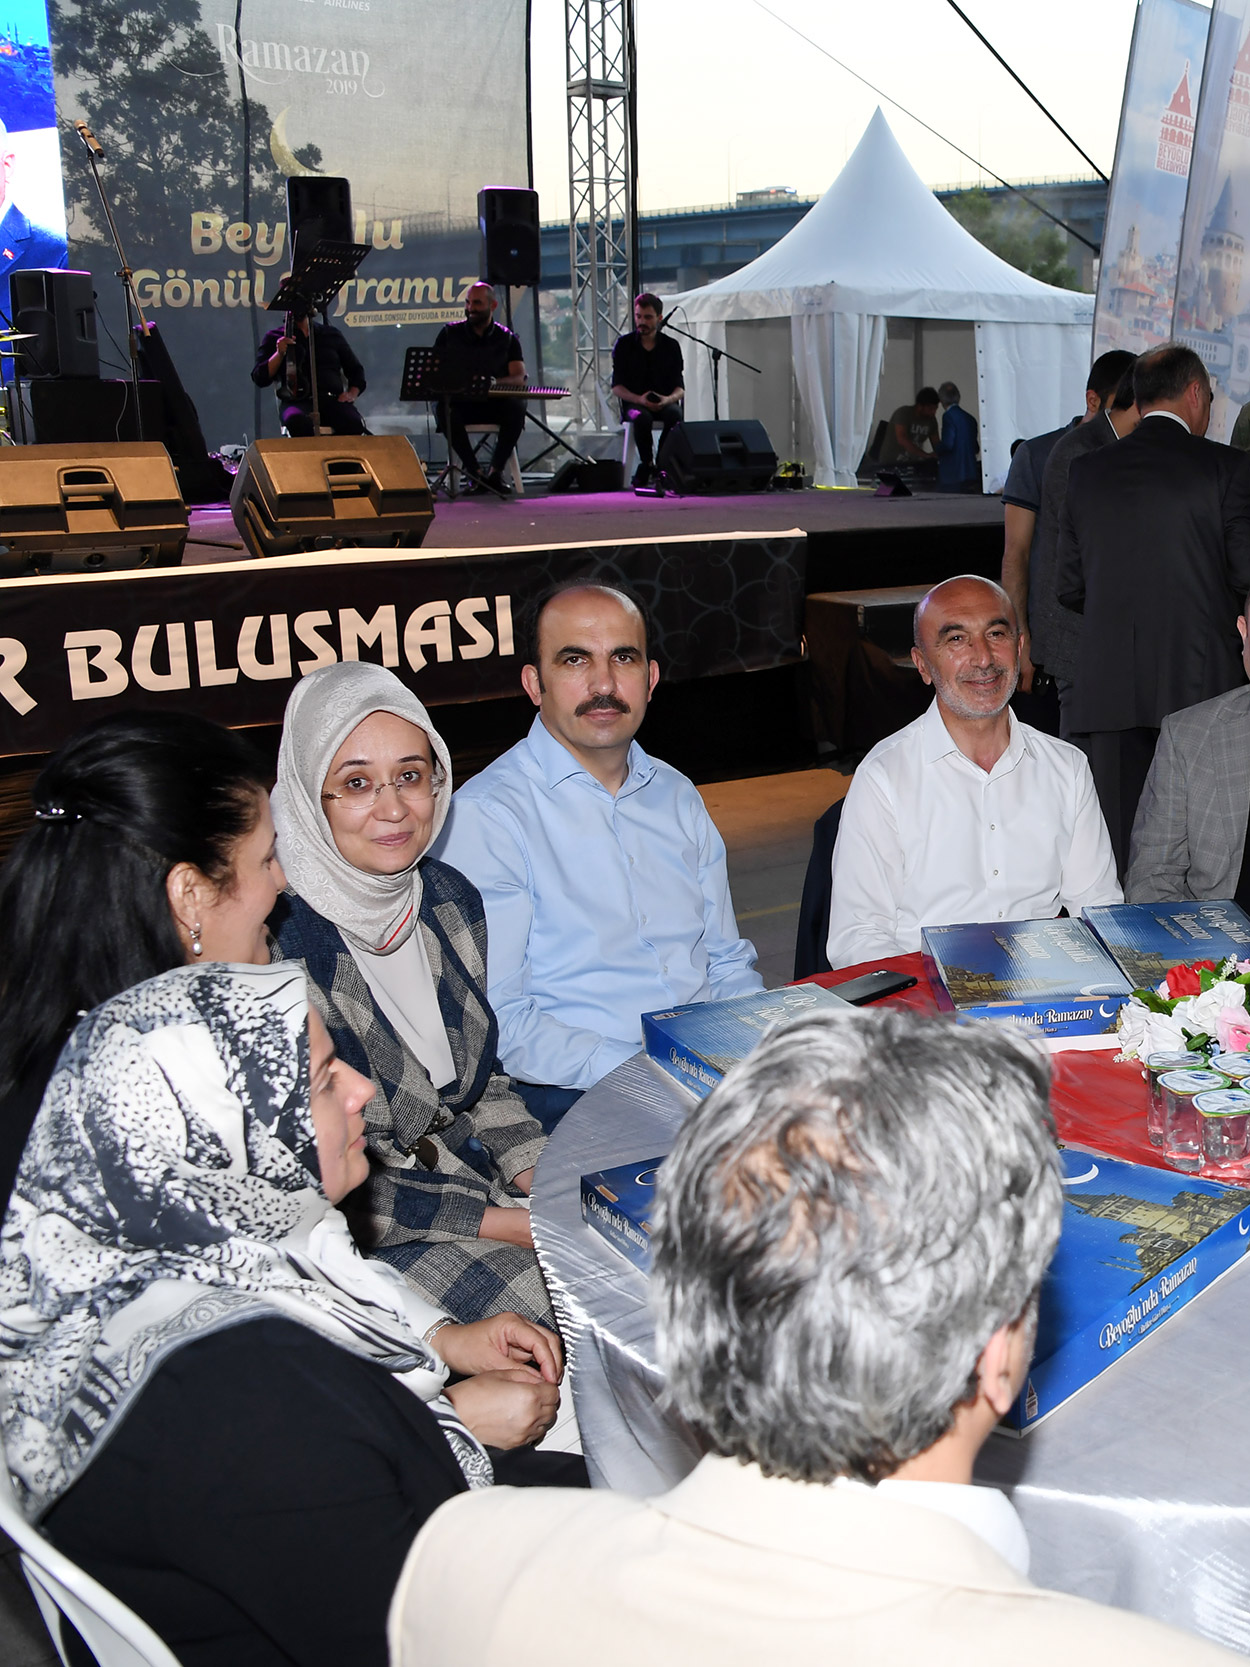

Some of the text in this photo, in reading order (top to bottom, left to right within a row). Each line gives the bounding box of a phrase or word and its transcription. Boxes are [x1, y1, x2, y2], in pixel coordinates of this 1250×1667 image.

[324, 0, 370, 12] AIRLINES
[180, 23, 385, 97] Ramazan
[325, 78, 358, 95] 2019
[191, 208, 404, 267] Beylu
[131, 268, 269, 309] Gönül
[440, 310, 466, 319] RAMAZ
[1044, 1008, 1093, 1023] Ramazan
[1099, 1288, 1159, 1349] Beyoğlu'nda
[1158, 1257, 1198, 1299] Ramazan
